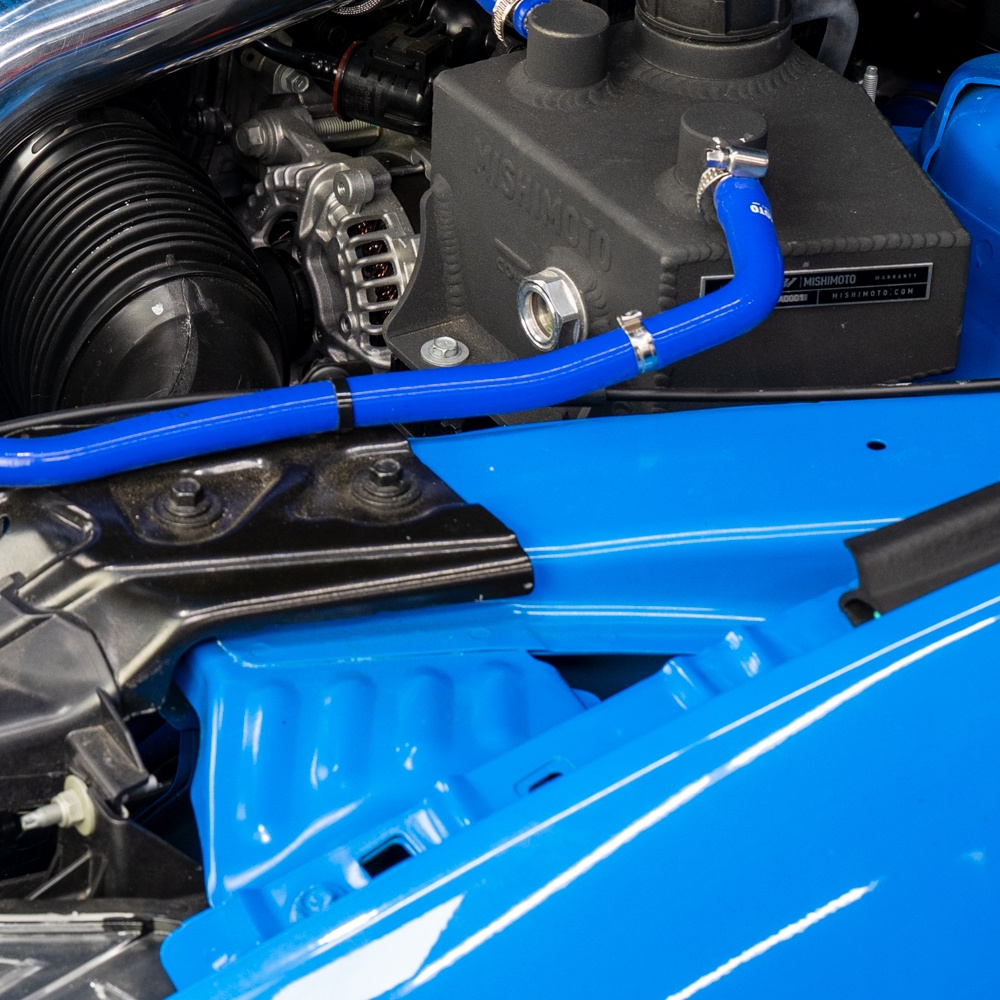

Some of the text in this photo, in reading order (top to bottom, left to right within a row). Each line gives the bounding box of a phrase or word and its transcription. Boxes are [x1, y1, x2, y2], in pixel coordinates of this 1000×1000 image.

[473, 137, 613, 273] MISHIMOTO
[803, 274, 857, 287] MISHIMOTO
[874, 273, 918, 281] WARRANTY
[832, 288, 914, 299] MISHIMOTO.COM
